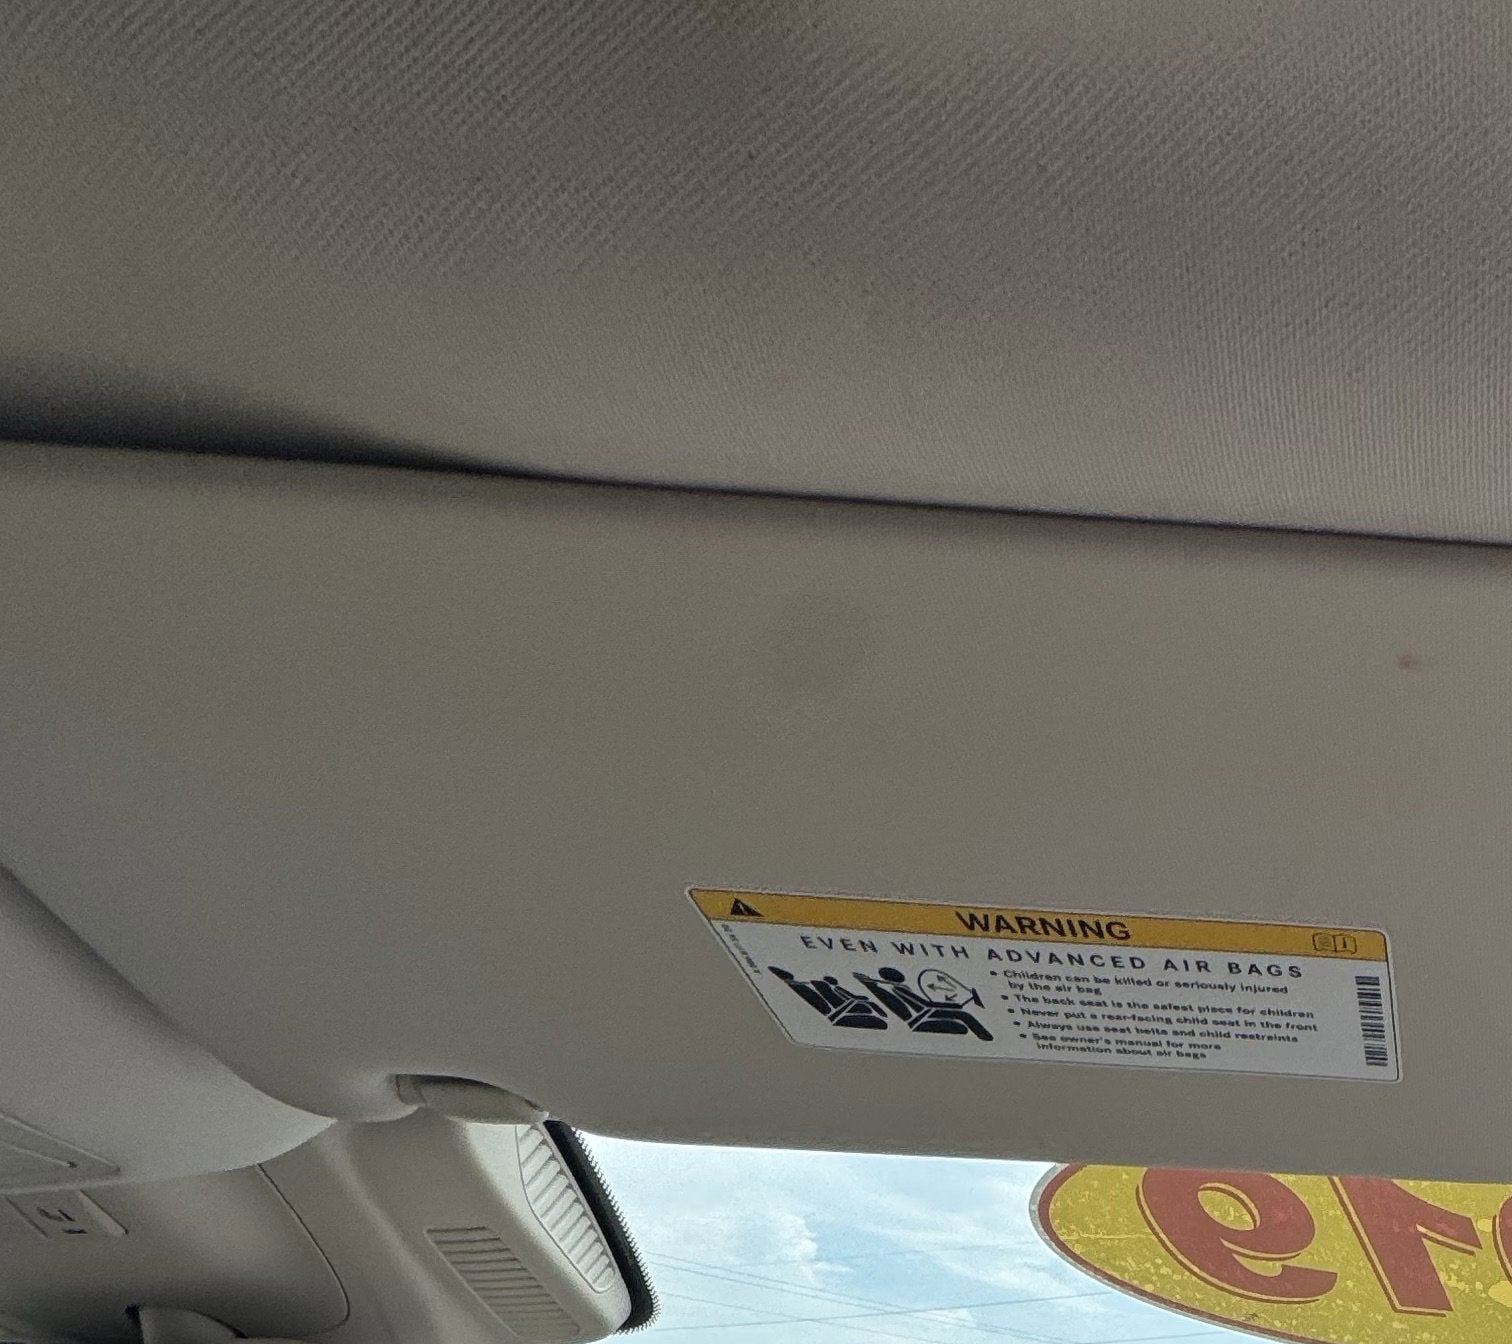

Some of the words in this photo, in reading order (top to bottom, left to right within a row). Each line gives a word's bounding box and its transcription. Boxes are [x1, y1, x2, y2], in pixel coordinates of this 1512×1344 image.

[955, 911, 1131, 940] WARNING
[800, 936, 878, 953] EVEN
[891, 942, 969, 959] WITH
[987, 949, 1146, 970] ADVANCED
[1163, 959, 1211, 973] AIR
[1227, 962, 1303, 978] BAGS
[1003, 969, 1062, 982] Children
[1065, 976, 1089, 984] can
[1094, 976, 1110, 985] be
[1115, 977, 1152, 987] killed
[1156, 980, 1170, 988] or
[1174, 981, 1236, 993] seriously
[1240, 982, 1289, 995] injured
[1008, 980, 1024, 992] by
[1028, 982, 1050, 991] the
[1055, 984, 1071, 993] air
[1014, 993, 1039, 1003] The
[1042, 995, 1075, 1006] back
[1079, 999, 1108, 1008] seat
[1127, 1000, 1149, 1010] the
[1153, 1002, 1194, 1012] safest
[1198, 1004, 1233, 1014] place
[1237, 1006, 1256, 1015] for
[1259, 1008, 1315, 1019] children
[1020, 1007, 1059, 1017] Never
[1064, 1010, 1086, 1020] put
[1101, 1012, 1173, 1025] rear-facing
[1176, 1017, 1208, 1026] child
[1212, 1019, 1240, 1027] seat
[1260, 1021, 1281, 1030] the
[1285, 1022, 1318, 1032] front
[1027, 1020, 1073, 1032] Always
[1076, 1024, 1100, 1033] use
[1104, 1025, 1131, 1034] seat
[1135, 1027, 1168, 1036] belts
[1172, 1029, 1196, 1038] and
[1199, 1030, 1231, 1039] child
[1234, 1032, 1298, 1043] restraints
[1032, 1032, 1056, 1042] See
[1060, 1034, 1111, 1045] owner's
[1115, 1037, 1163, 1048] manual
[1166, 1039, 1184, 1049] for
[1188, 1042, 1222, 1051] more
[1036, 1042, 1112, 1054] information
[1116, 1046, 1153, 1057] about
[1176, 1051, 1207, 1060] bags
